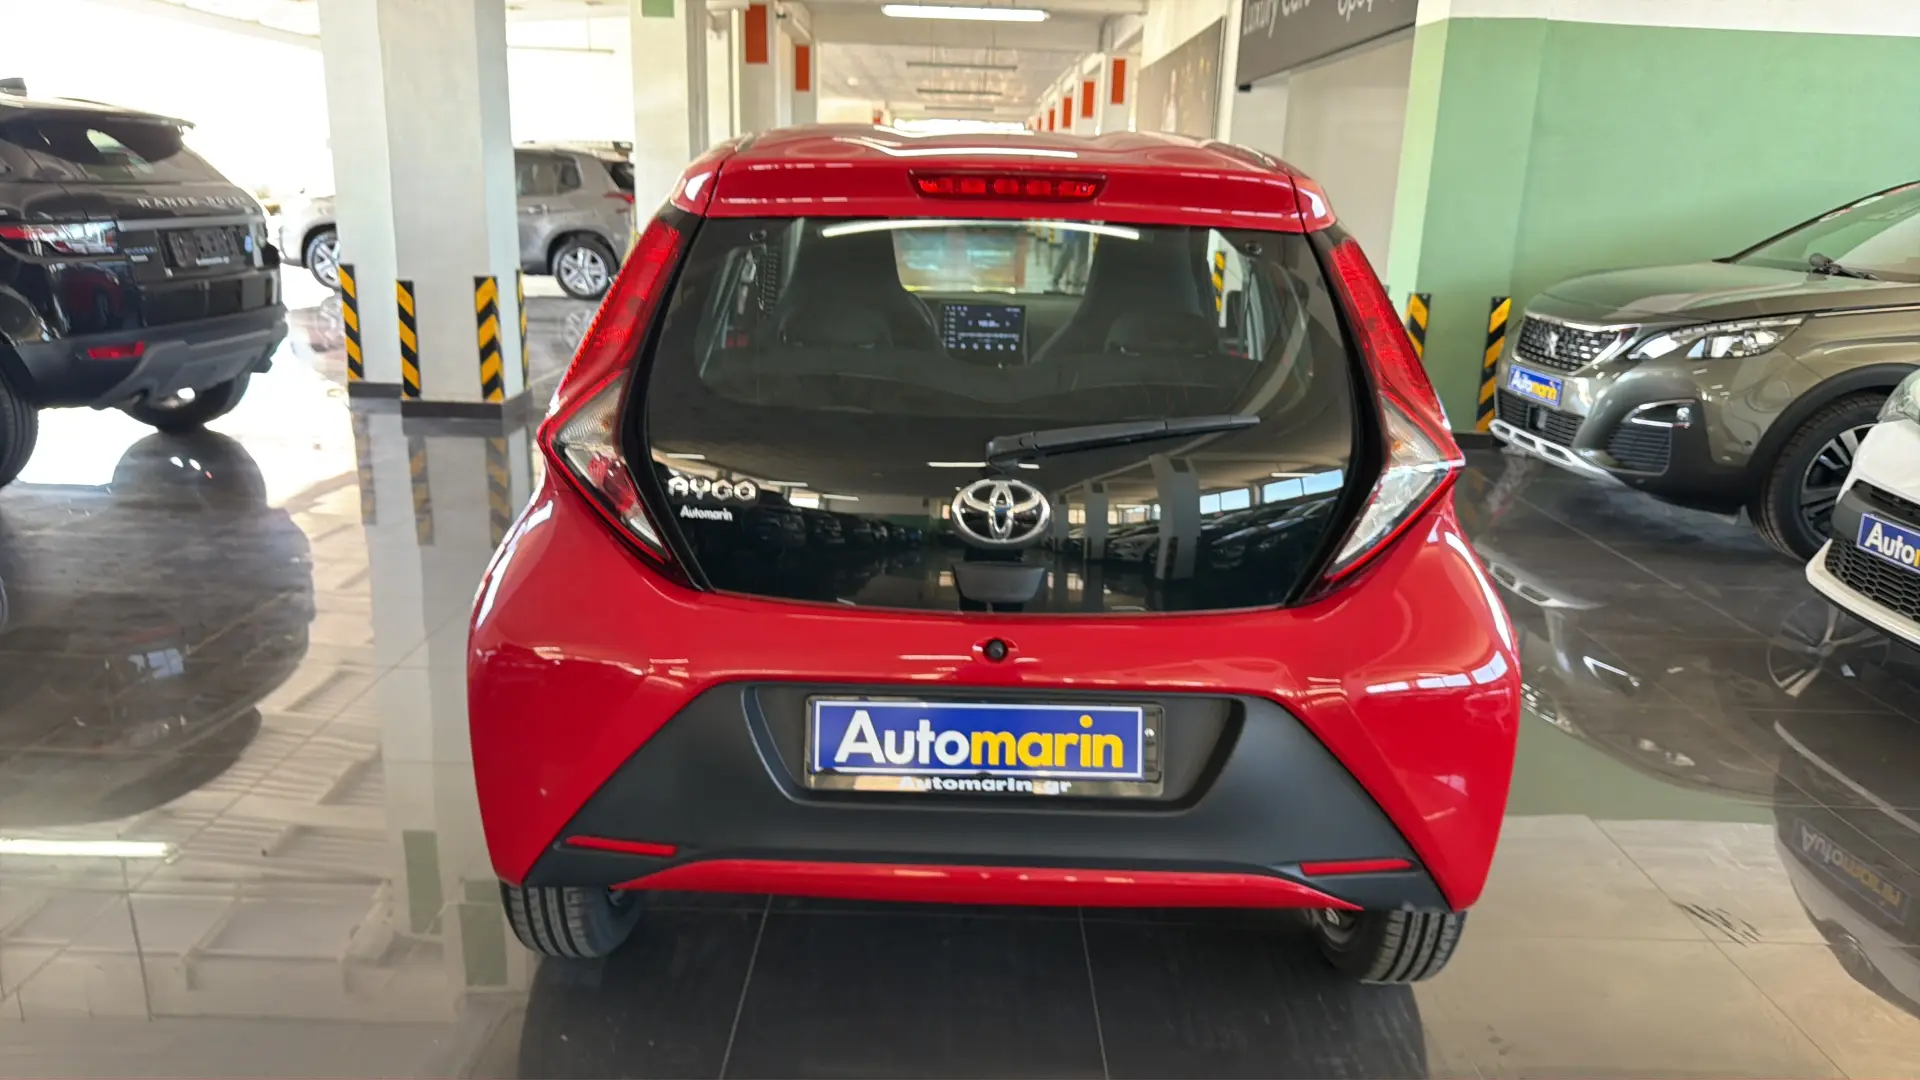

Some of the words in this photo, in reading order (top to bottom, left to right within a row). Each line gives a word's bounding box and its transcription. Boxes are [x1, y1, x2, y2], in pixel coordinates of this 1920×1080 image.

[668, 476, 756, 500] AYGO
[680, 504, 733, 521] Automarin
[1864, 521, 1920, 567] Auto
[834, 709, 1124, 768] Automarin
